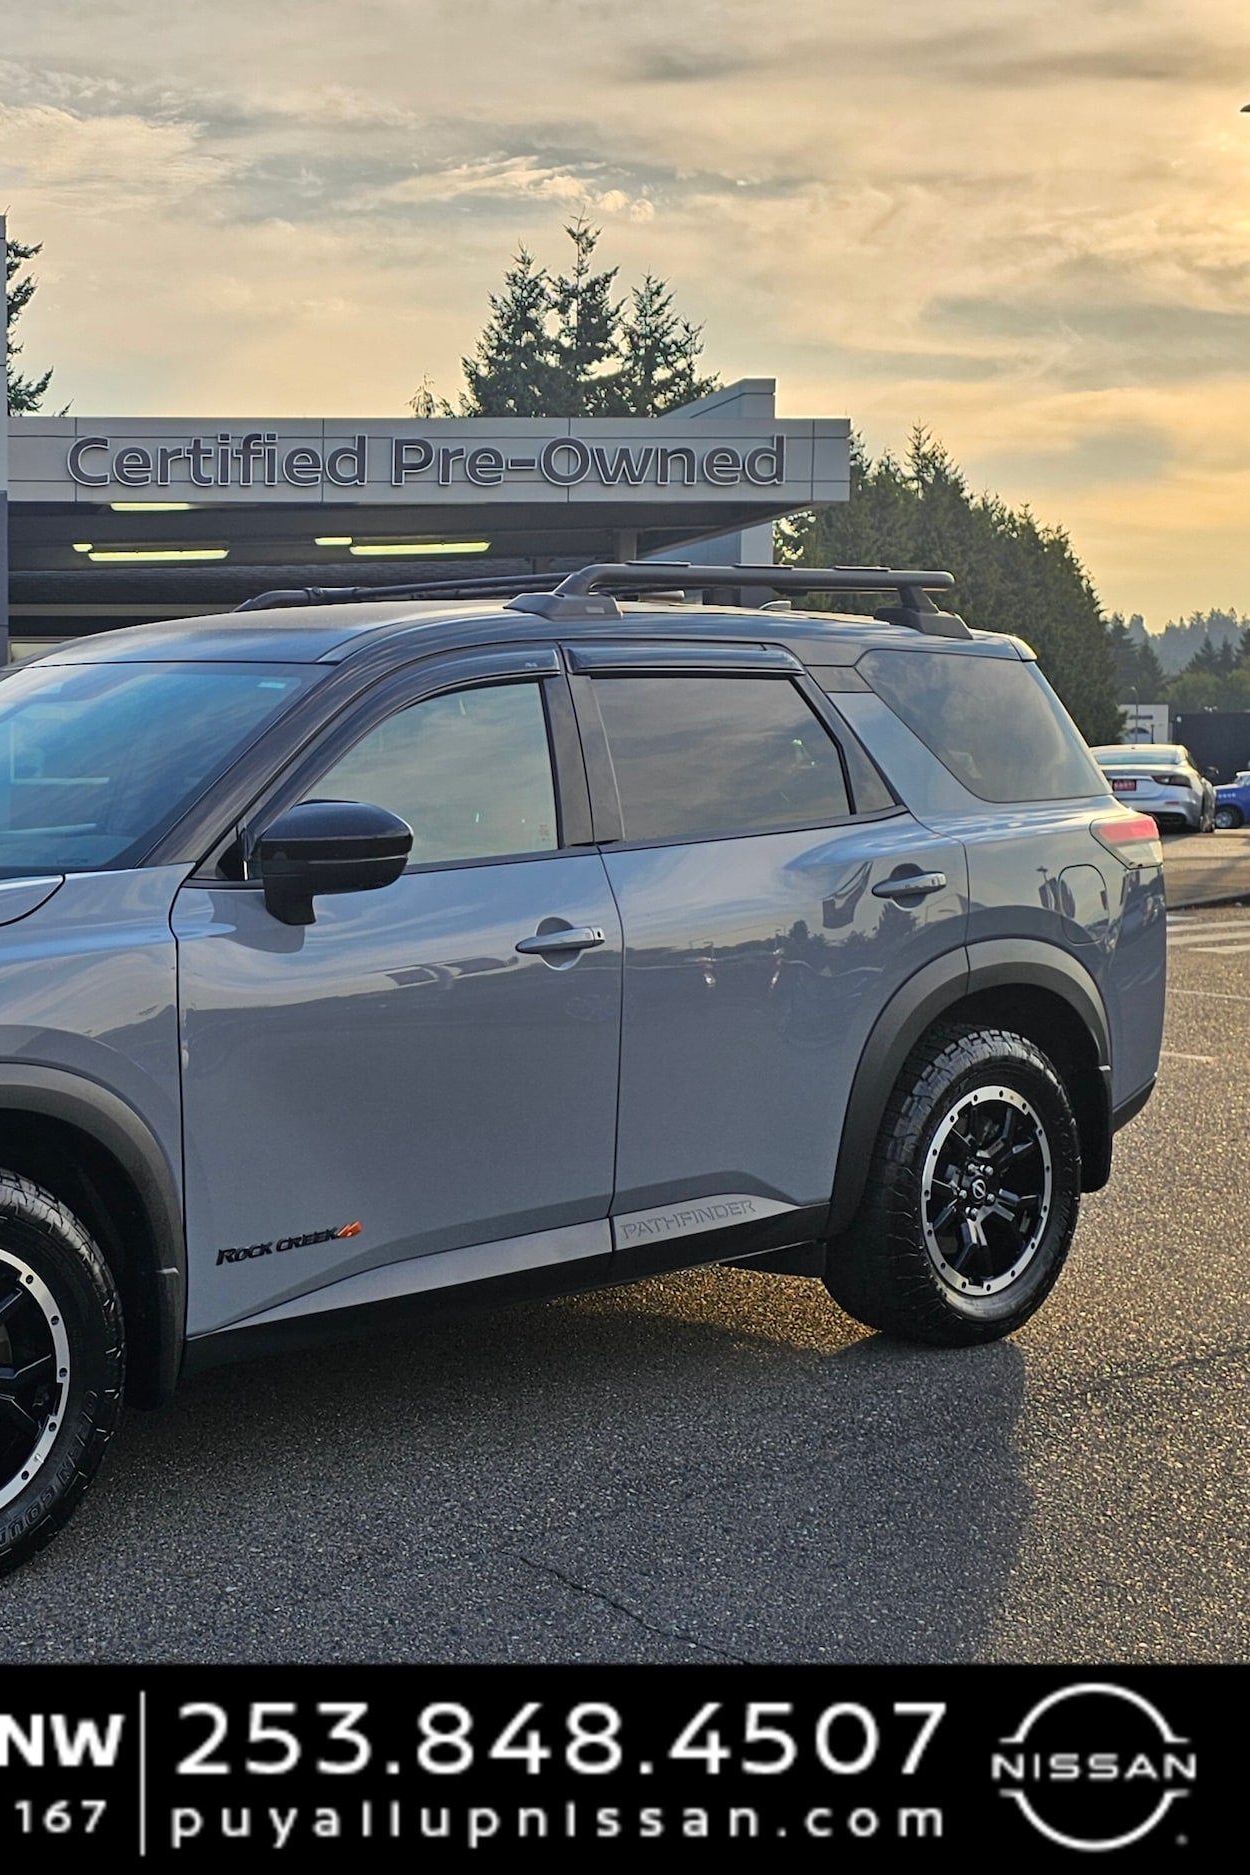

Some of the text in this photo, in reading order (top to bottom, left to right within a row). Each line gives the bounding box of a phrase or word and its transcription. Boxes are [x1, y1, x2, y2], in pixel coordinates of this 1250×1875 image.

[67, 433, 787, 488] Certified Pre-Owned
[620, 1200, 757, 1240] PATHFINDER
